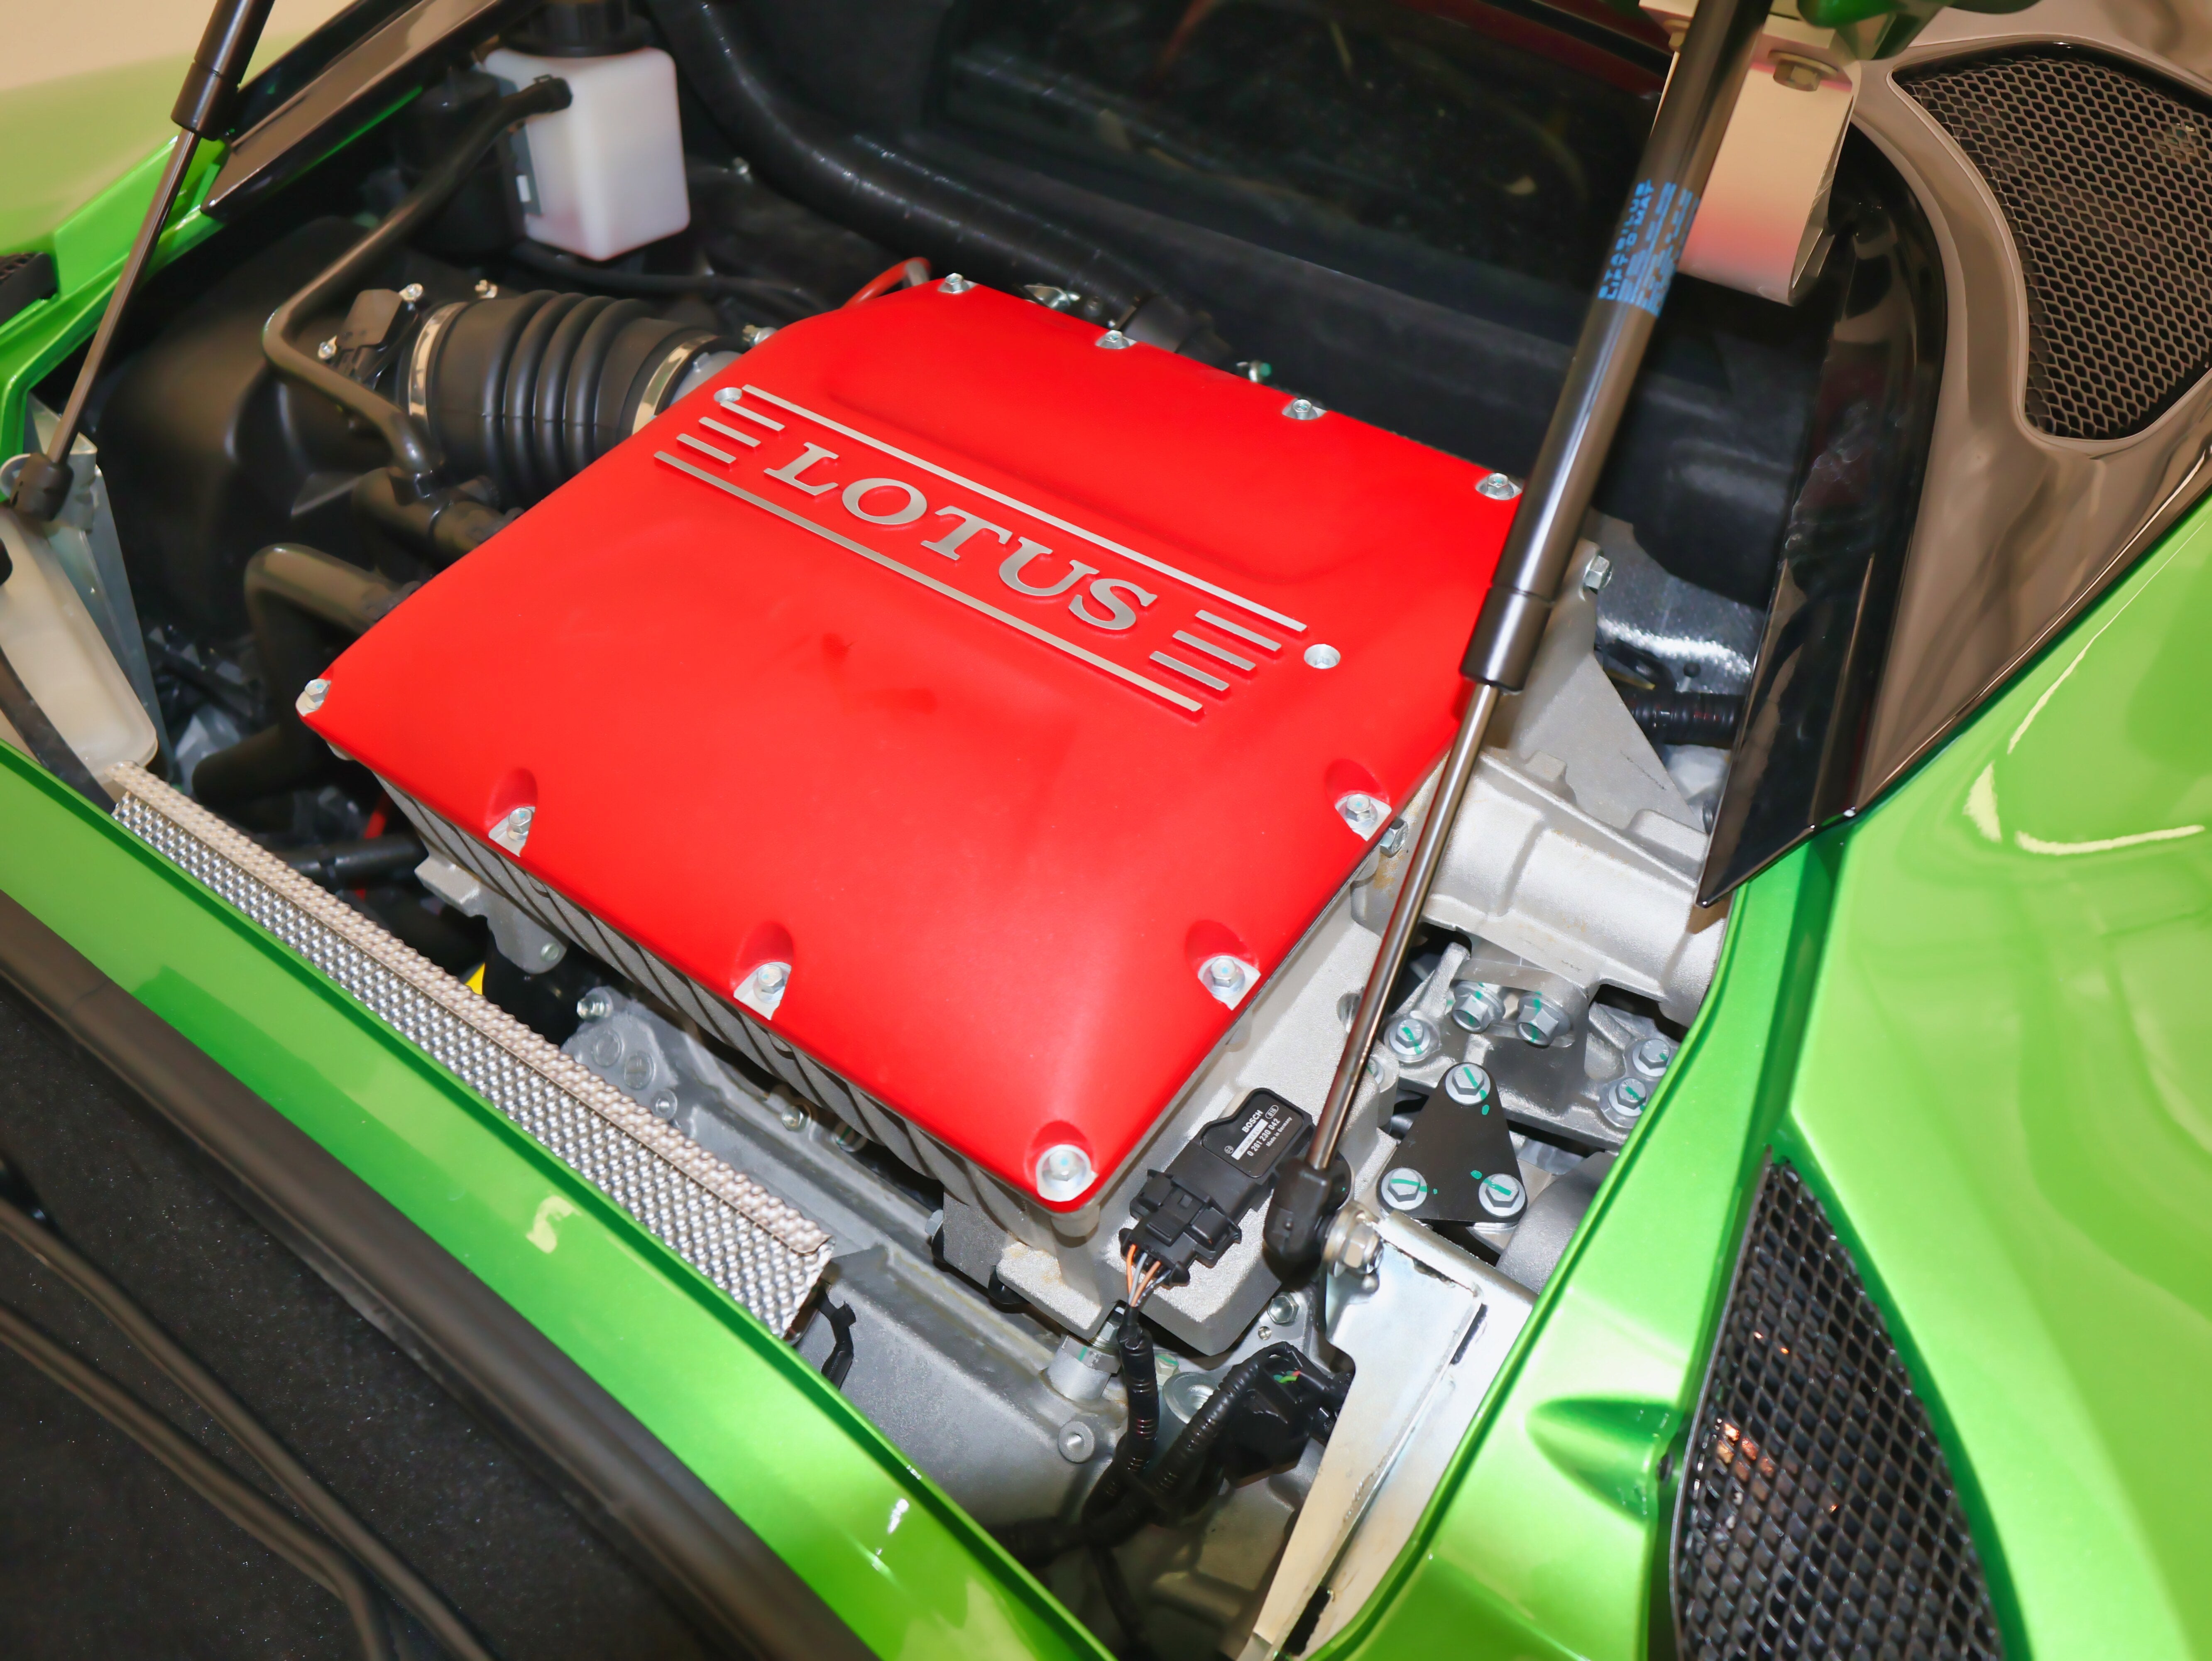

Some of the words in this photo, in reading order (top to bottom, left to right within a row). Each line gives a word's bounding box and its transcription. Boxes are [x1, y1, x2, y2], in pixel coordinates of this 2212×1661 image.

[763, 442, 1157, 630] LOTUS
[1241, 1110, 1263, 1133] BOSCH
[1268, 1108, 1276, 1117] 816
[1251, 1140, 1263, 1151] 261
[1259, 1129, 1271, 1142] 230
[1268, 1118, 1280, 1130] 042
[1266, 1137, 1276, 1147] Made
[1277, 1117, 1292, 1133] Germany
